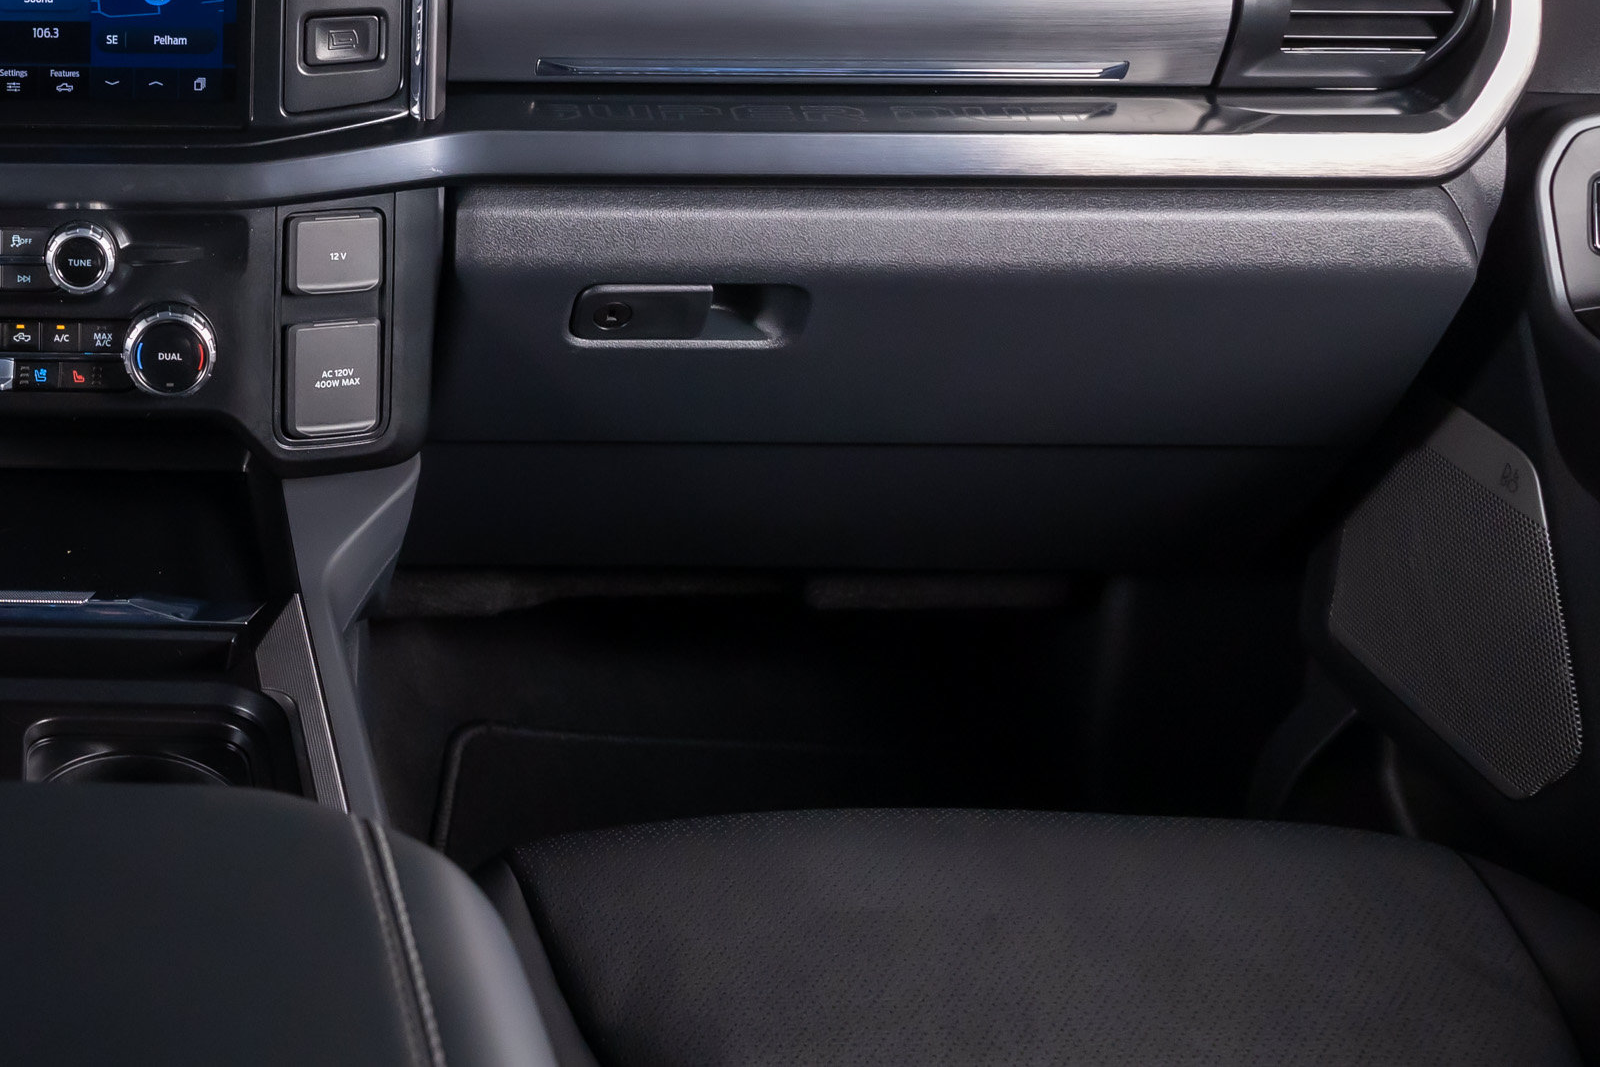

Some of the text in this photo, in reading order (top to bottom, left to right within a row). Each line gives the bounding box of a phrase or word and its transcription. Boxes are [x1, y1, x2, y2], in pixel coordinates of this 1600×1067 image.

[32, 27, 60, 39] 106.3
[106, 35, 119, 45] SE
[153, 35, 188, 46] Pelham
[0, 68, 28, 79] Settings
[50, 68, 81, 78] Features
[329, 252, 347, 261] 12 V
[68, 259, 92, 267] TUNE
[53, 334, 70, 343] A/C
[93, 332, 113, 341] MAX
[95, 339, 112, 347] A/C
[158, 352, 183, 361] DUAL
[321, 368, 355, 378] AC 120V
[314, 377, 361, 389] 400W MAX
